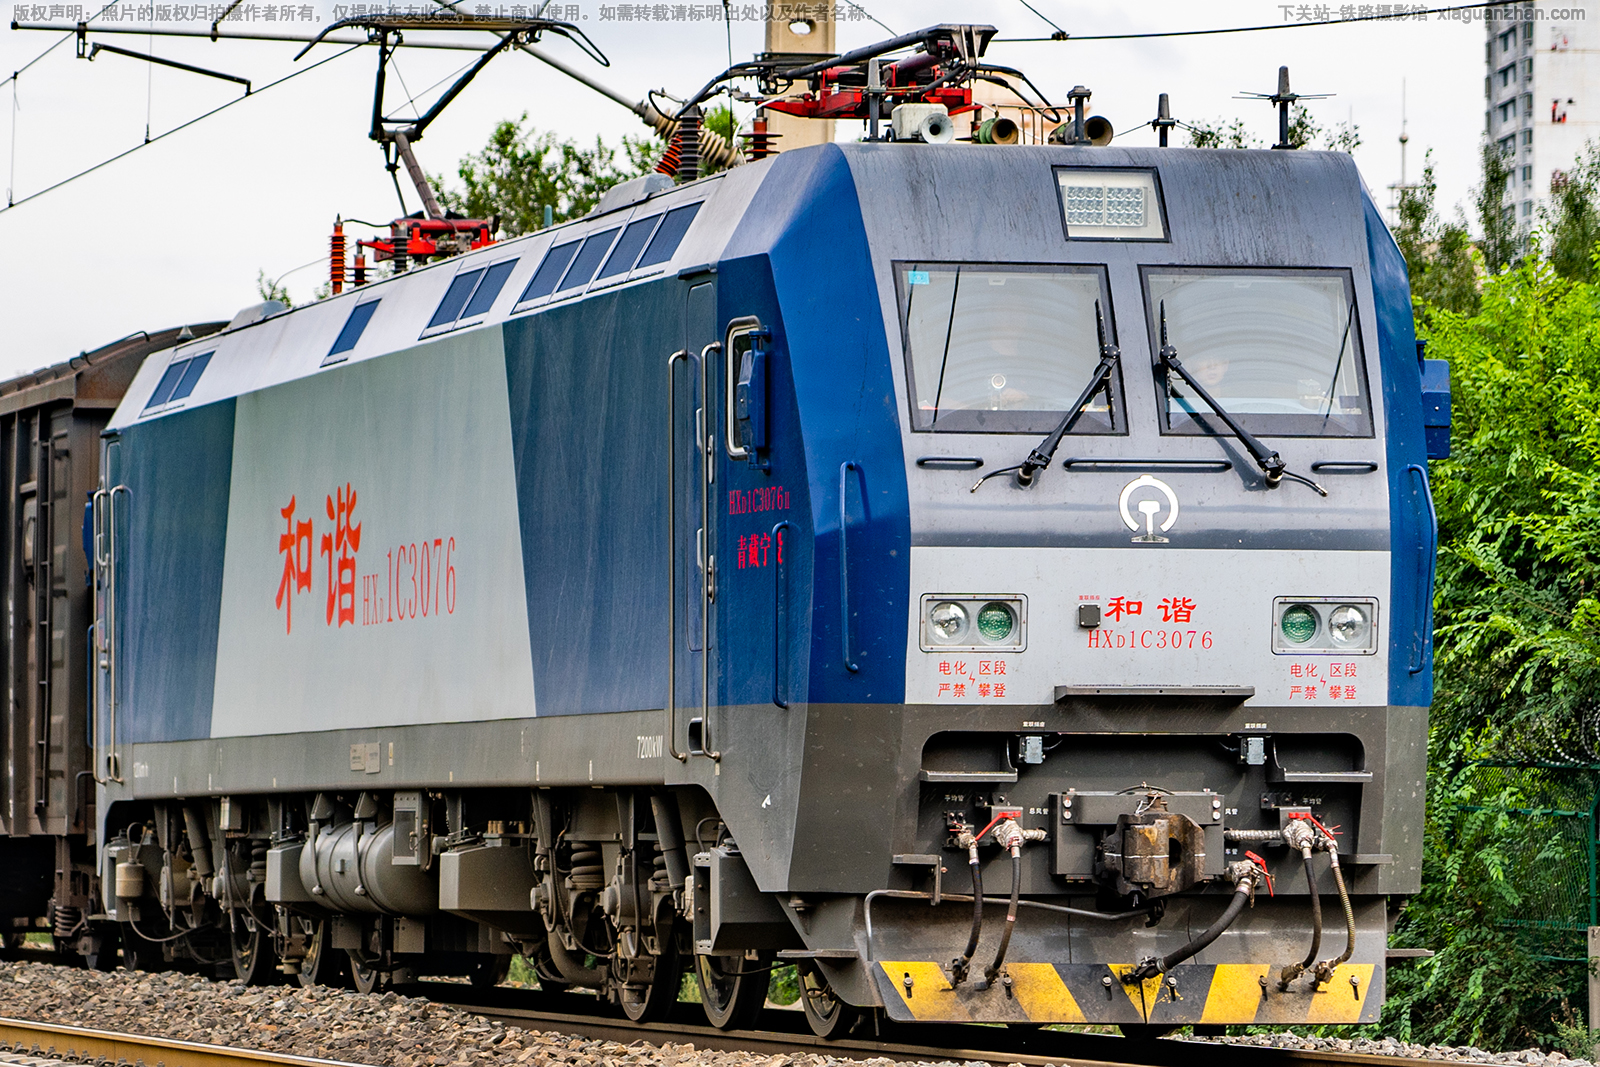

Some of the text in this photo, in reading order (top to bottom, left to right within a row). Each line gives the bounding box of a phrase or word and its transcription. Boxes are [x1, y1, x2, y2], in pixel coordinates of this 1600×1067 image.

[275, 482, 362, 635] 和谐
[1104, 596, 1197, 623] 和谐
[1087, 630, 1213, 649] HXD1C3076
